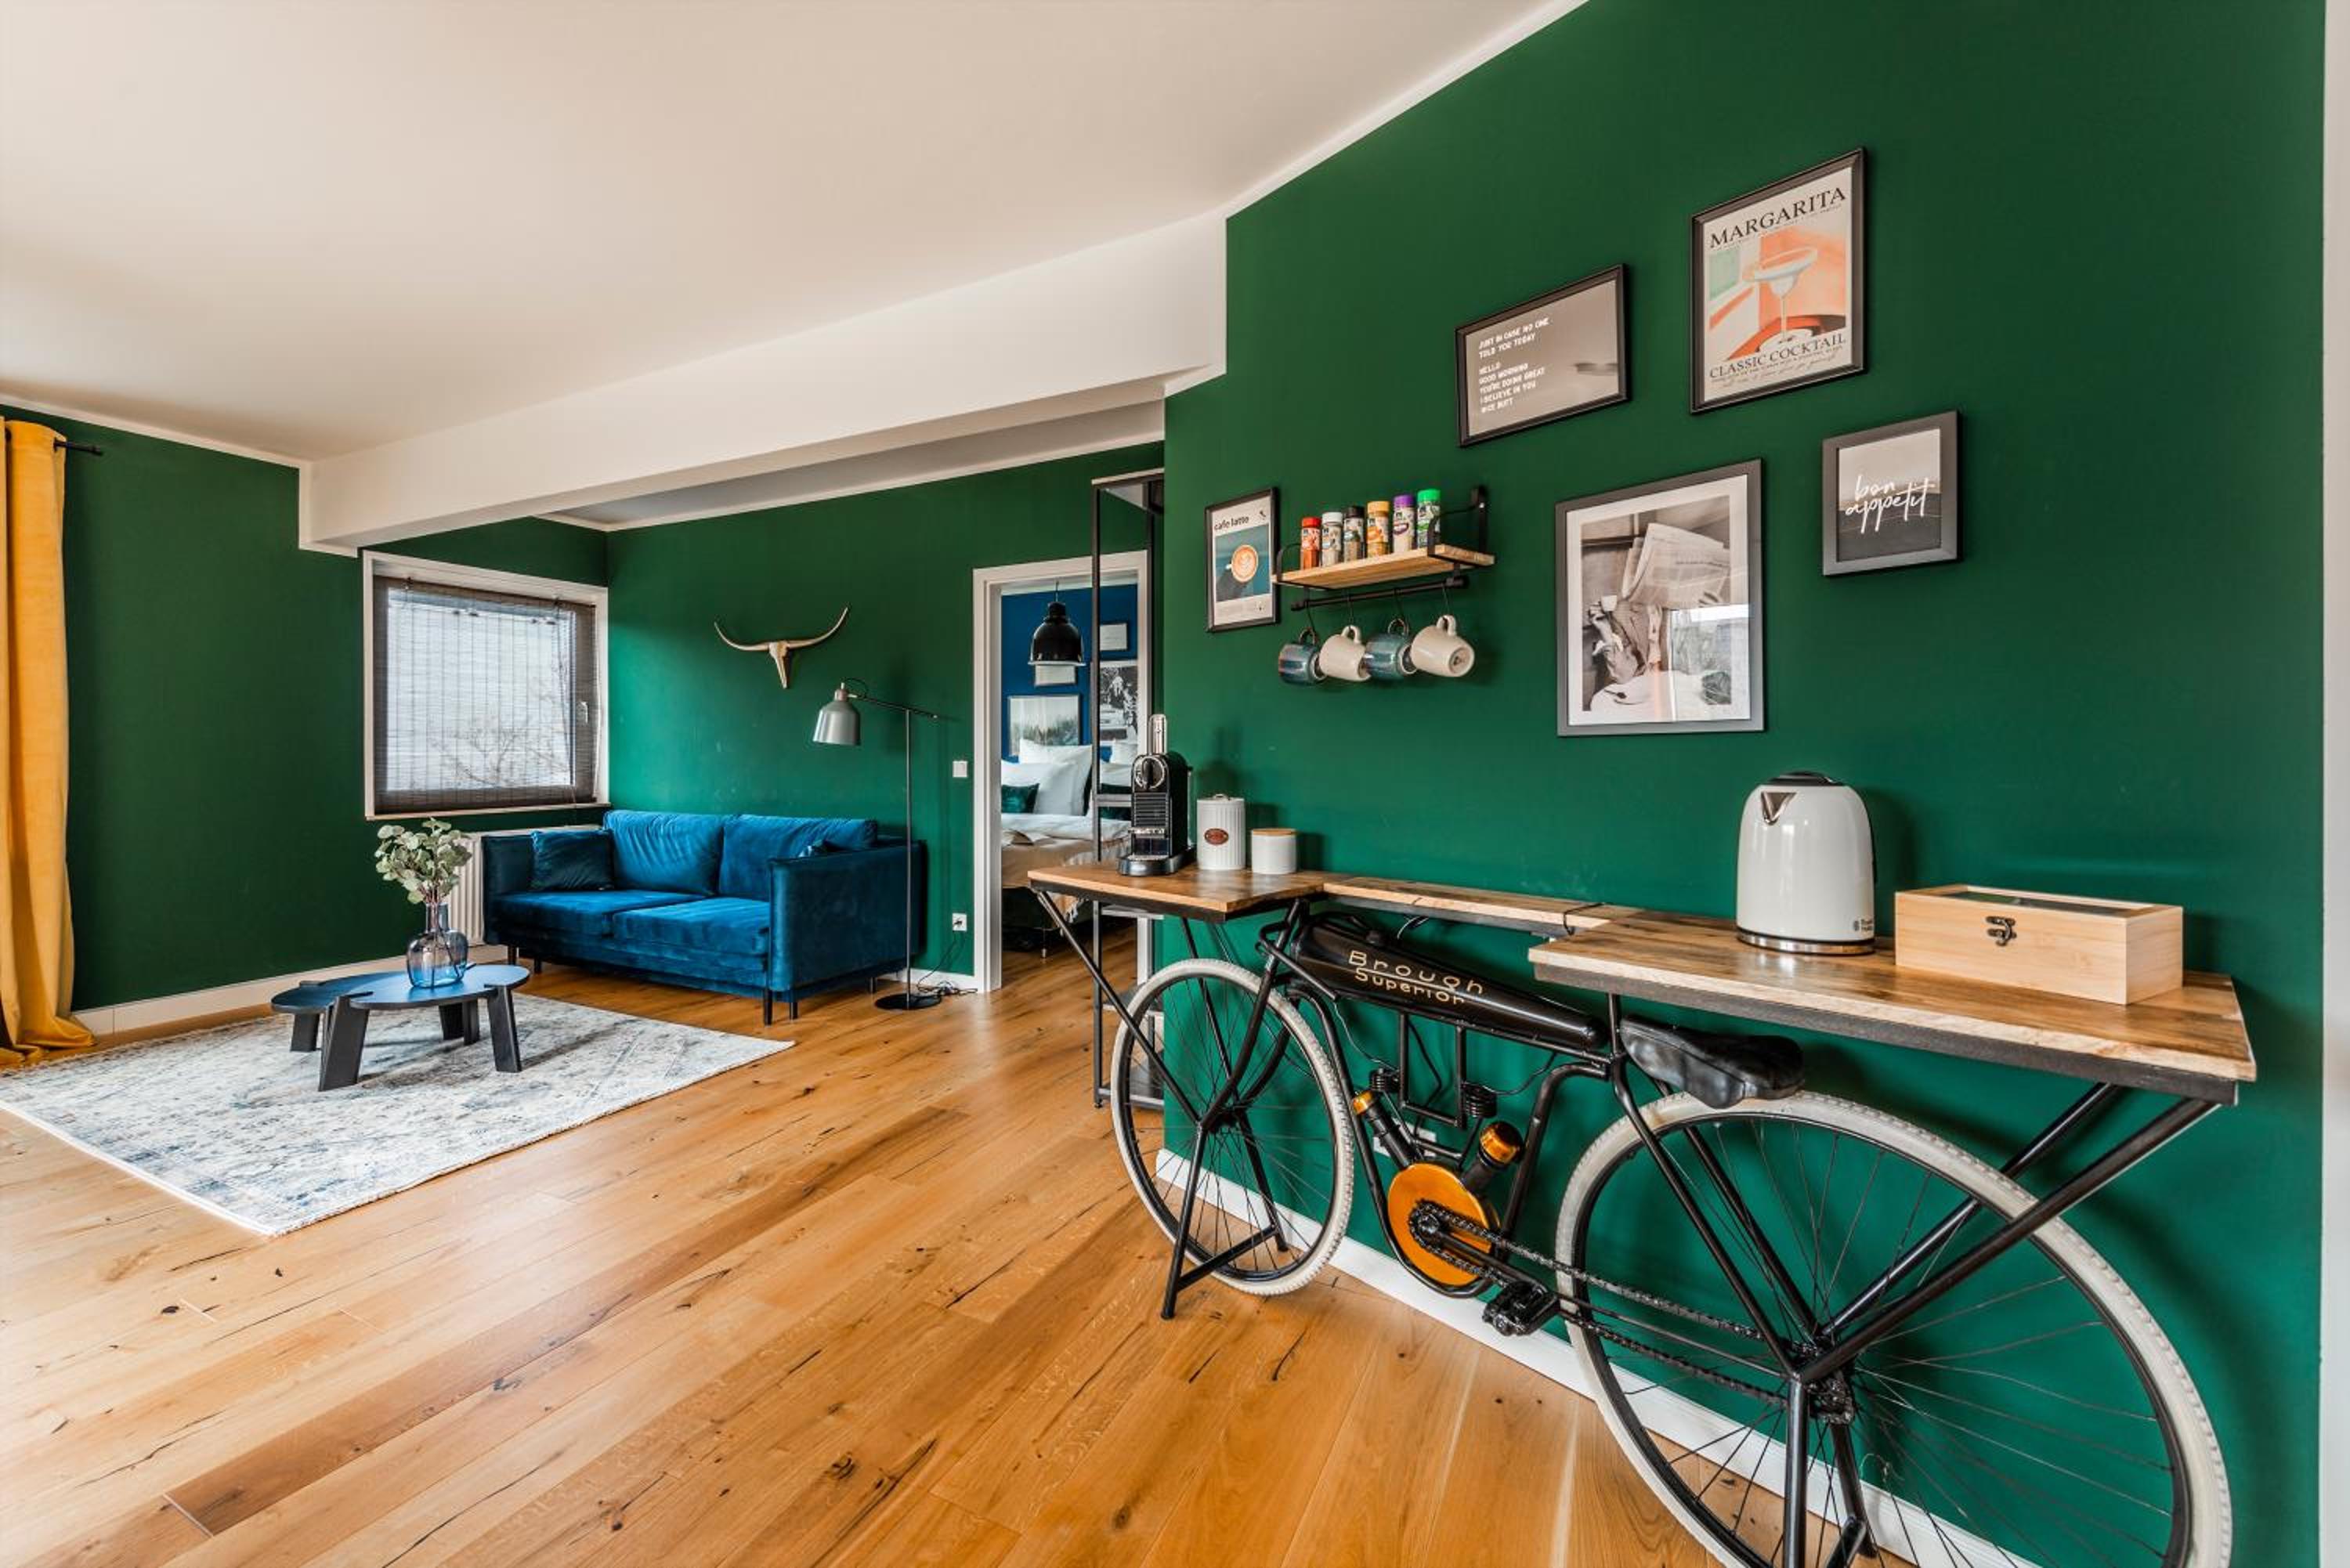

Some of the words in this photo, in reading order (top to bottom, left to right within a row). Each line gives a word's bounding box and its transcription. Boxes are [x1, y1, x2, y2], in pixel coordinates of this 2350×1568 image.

[1709, 187, 1846, 249] MARGARITA
[1709, 354, 1767, 378] CLASSIC
[1769, 333, 1846, 361] COCKTAIL
[1845, 477, 1936, 534] appetit
[1854, 474, 1896, 501] bon
[1231, 516, 1249, 527] latte
[1348, 949, 1484, 995] Brough
[1354, 968, 1466, 1005] Superior
